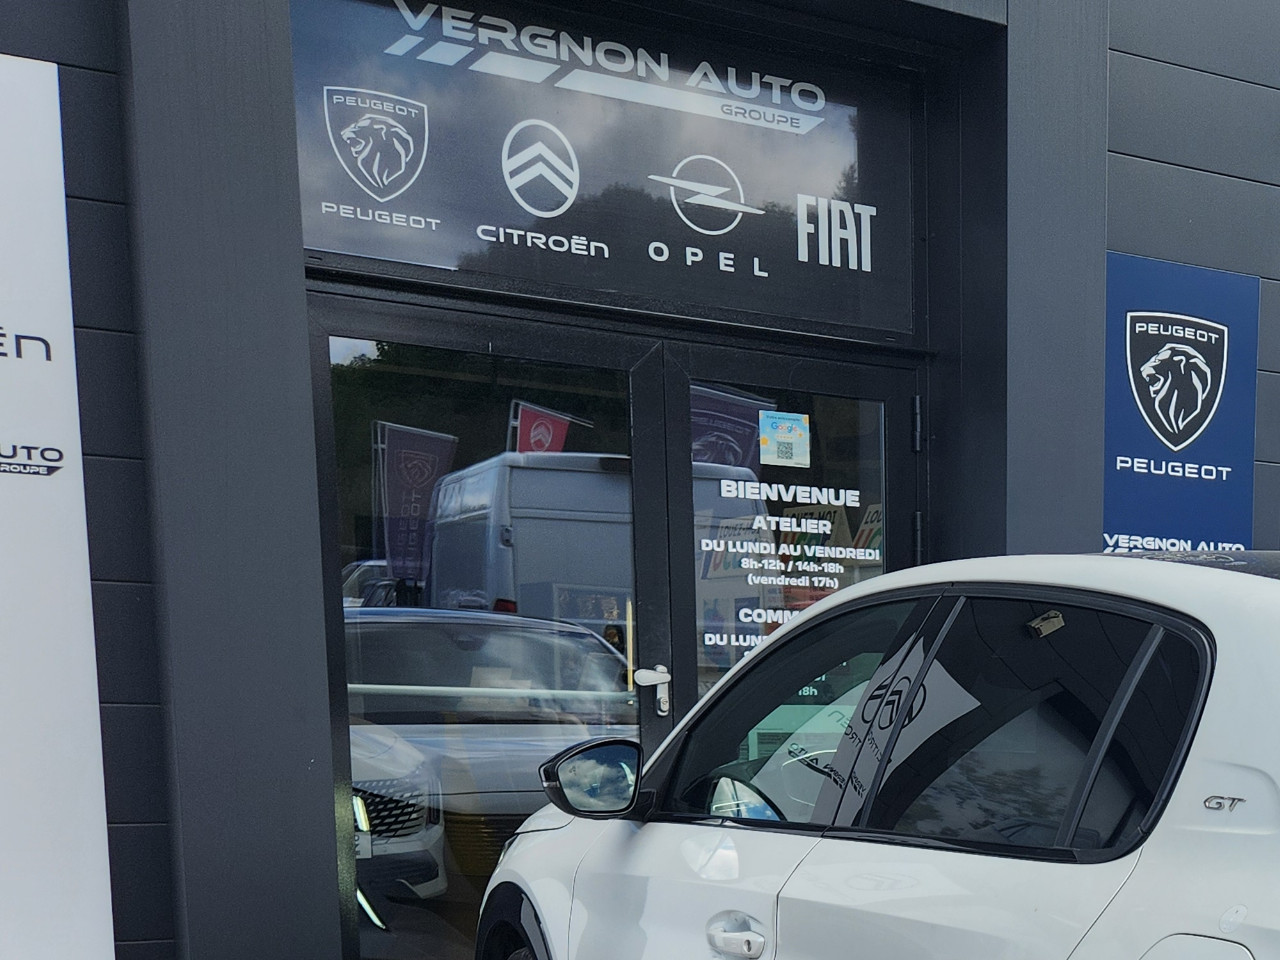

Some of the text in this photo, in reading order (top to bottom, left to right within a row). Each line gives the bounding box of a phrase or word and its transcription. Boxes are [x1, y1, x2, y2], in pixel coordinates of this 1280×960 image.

[392, 0, 827, 111] VERGNON AUTO
[332, 94, 420, 119] PEUGEOT
[720, 104, 801, 129] GROUPE
[321, 201, 441, 232] PEUGEOT
[796, 192, 877, 273] FIAT
[647, 241, 770, 278] OPEL
[1136, 322, 1220, 345] PEUGEOT
[0, 444, 64, 462] UTO
[0, 463, 48, 475] ROUPE
[1116, 456, 1232, 482] PEUGEOT
[720, 479, 861, 507] BIENVENUE
[752, 515, 832, 535] ATELIER
[700, 538, 725, 552] DU
[728, 540, 776, 555] LUNDI
[778, 543, 802, 556] AU
[804, 545, 881, 561] VENDREDI
[1103, 533, 1246, 552] VERGNON AUTO
[740, 558, 845, 574] 8h-12h / 14h-18h
[747, 573, 839, 589] (vendredi 17h)
[738, 608, 800, 624] COMM
[704, 633, 769, 647] DU LUN
[1203, 795, 1247, 813] GT
